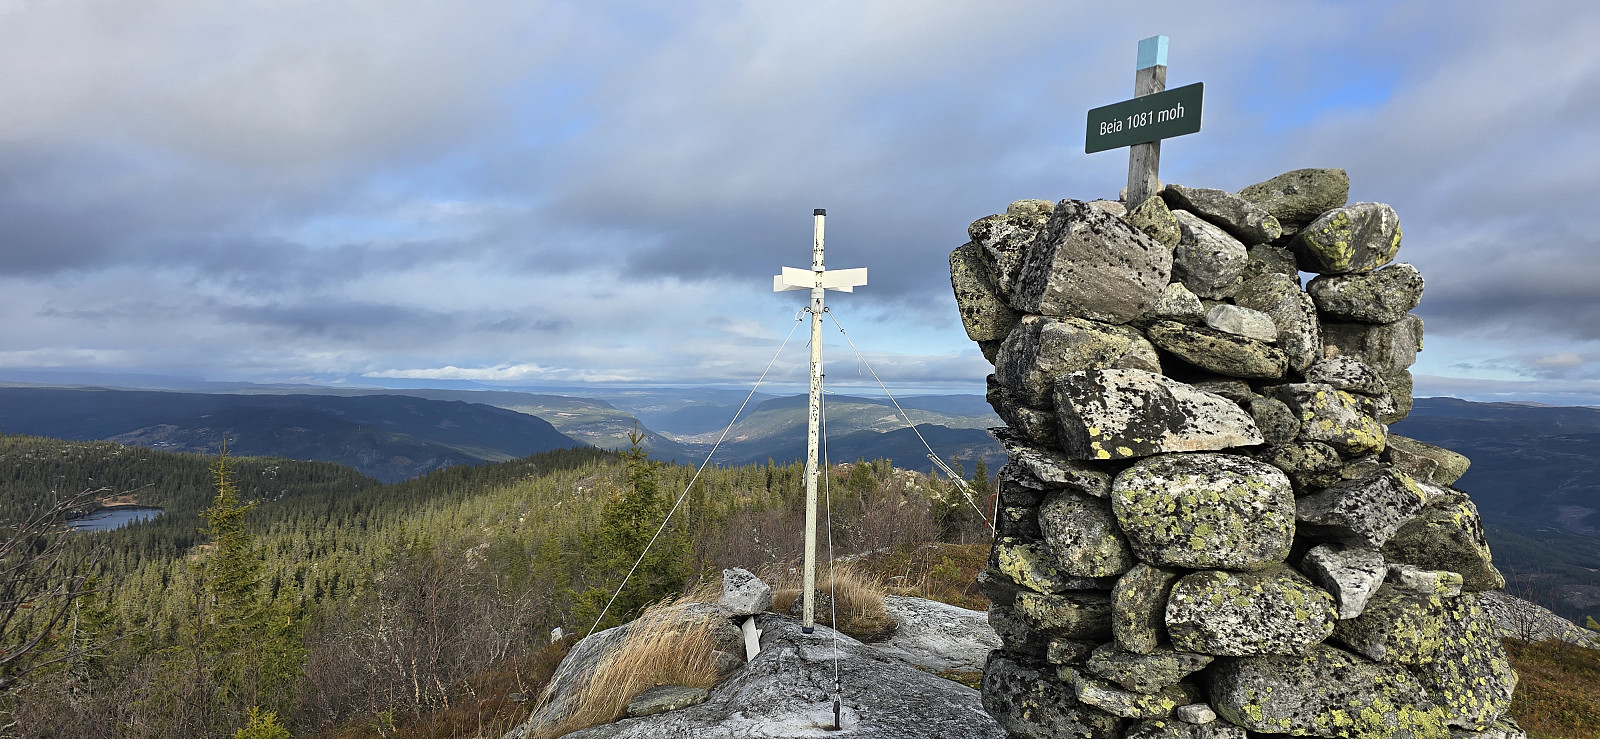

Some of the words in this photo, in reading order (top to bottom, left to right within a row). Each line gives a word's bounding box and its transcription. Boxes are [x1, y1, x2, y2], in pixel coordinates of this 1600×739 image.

[1100, 118, 1122, 136] Beia
[1127, 110, 1153, 130] 1081
[1157, 102, 1184, 123] moh
